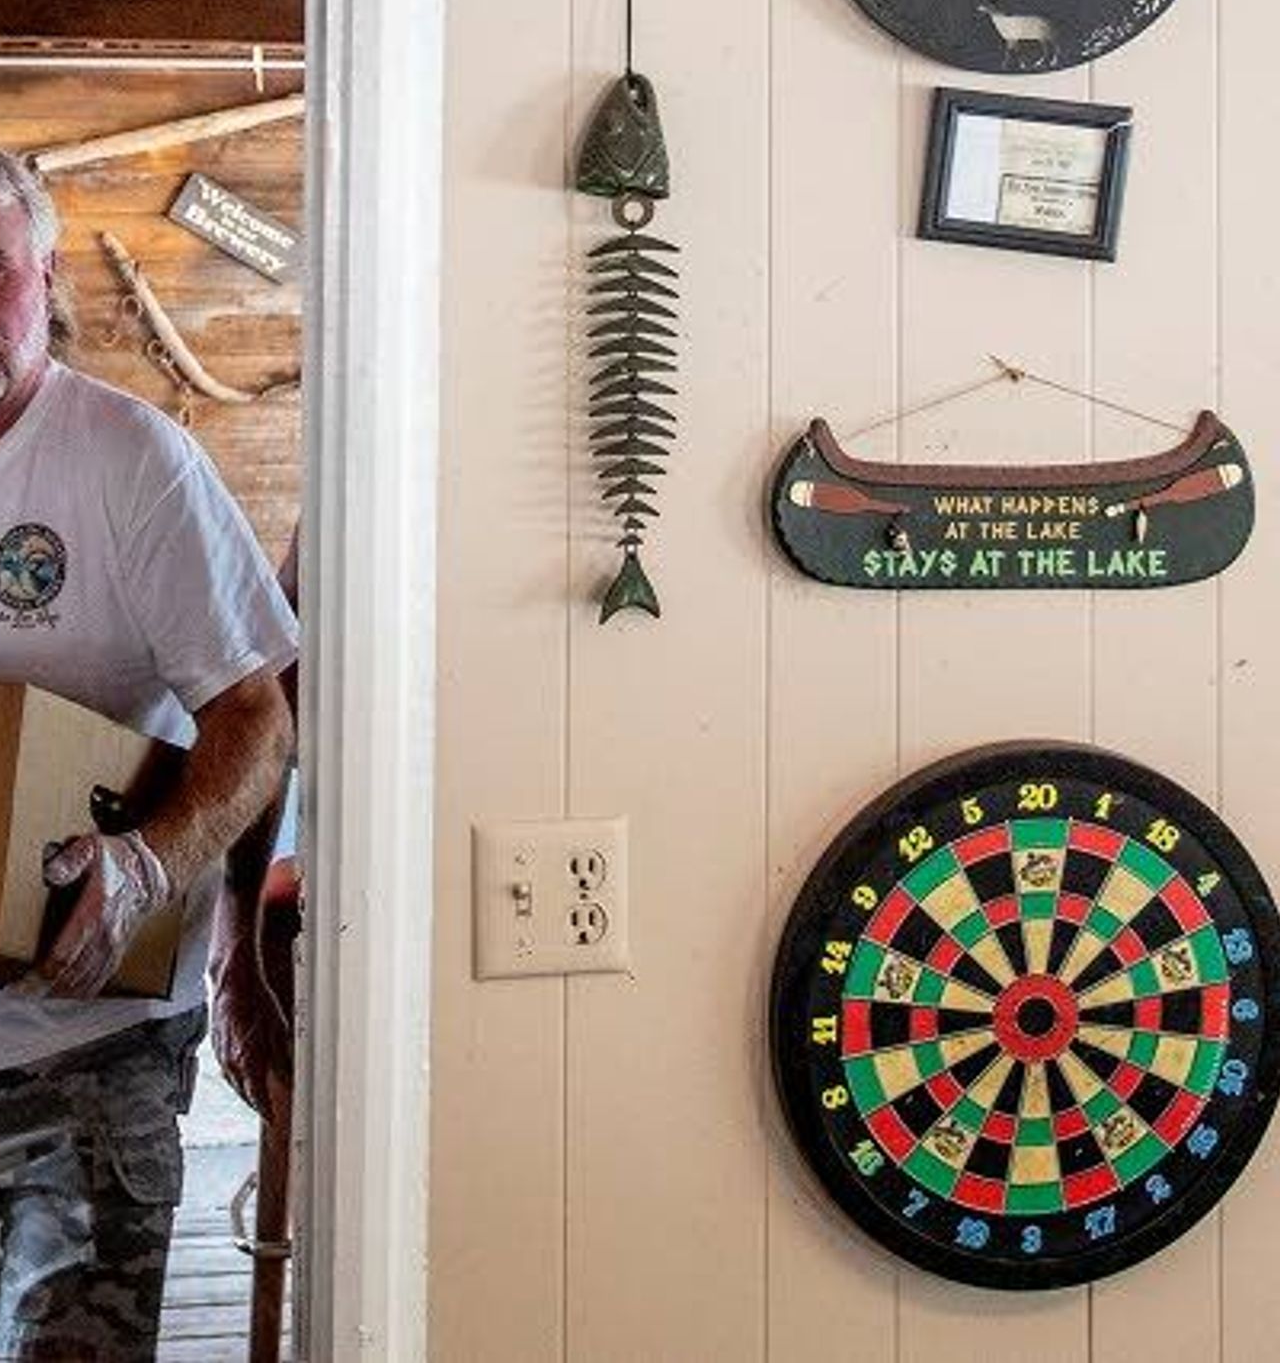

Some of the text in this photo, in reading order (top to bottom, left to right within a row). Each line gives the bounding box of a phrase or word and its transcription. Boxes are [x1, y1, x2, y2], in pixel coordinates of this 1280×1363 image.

[933, 495, 1102, 517] WHAT HAPPENS
[944, 522, 1083, 540] AT THE LAKE
[862, 549, 1168, 578] STAYS AT THE LAKE
[961, 797, 984, 824] 5
[1018, 783, 1058, 811] 20
[1094, 793, 1113, 821] 1
[899, 825, 933, 863] 12
[1145, 818, 1181, 853] 18
[851, 885, 878, 911] 9
[821, 939, 852, 975] 14
[811, 1014, 837, 1045] 11
[821, 1084, 849, 1110] 8
